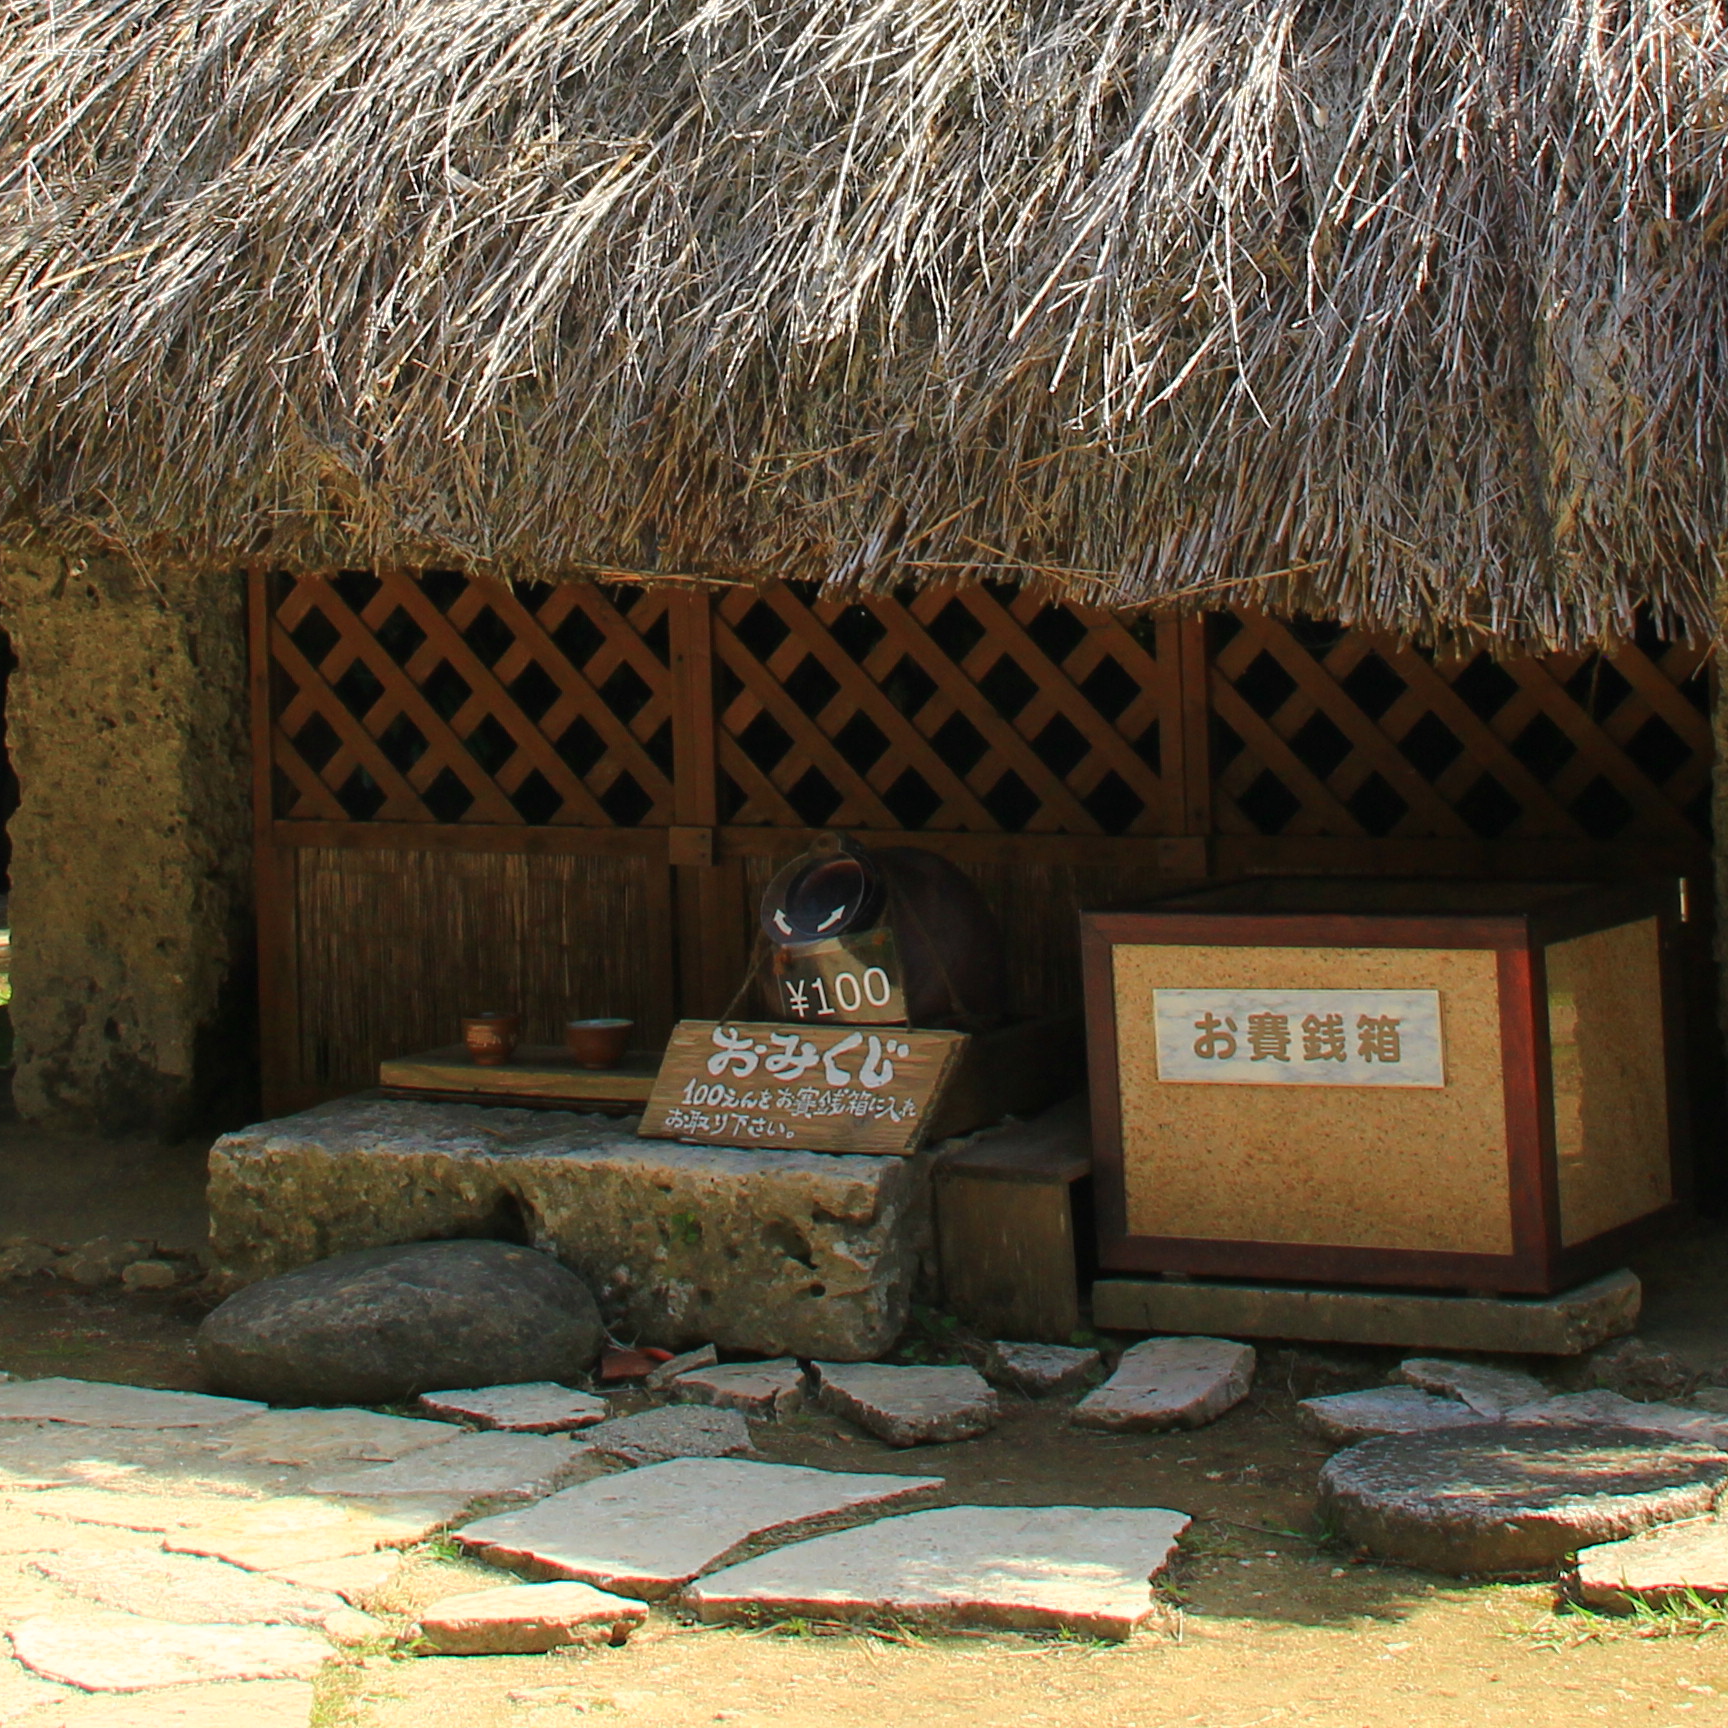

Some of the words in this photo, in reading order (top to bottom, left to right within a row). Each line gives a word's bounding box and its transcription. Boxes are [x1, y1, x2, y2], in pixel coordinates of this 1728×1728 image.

[785, 966, 891, 1018] ¥100
[707, 1025, 910, 1089] おみくじ
[1193, 1011, 1401, 1063] お賽銭箱
[664, 1108, 795, 1139] お取り下さい。
